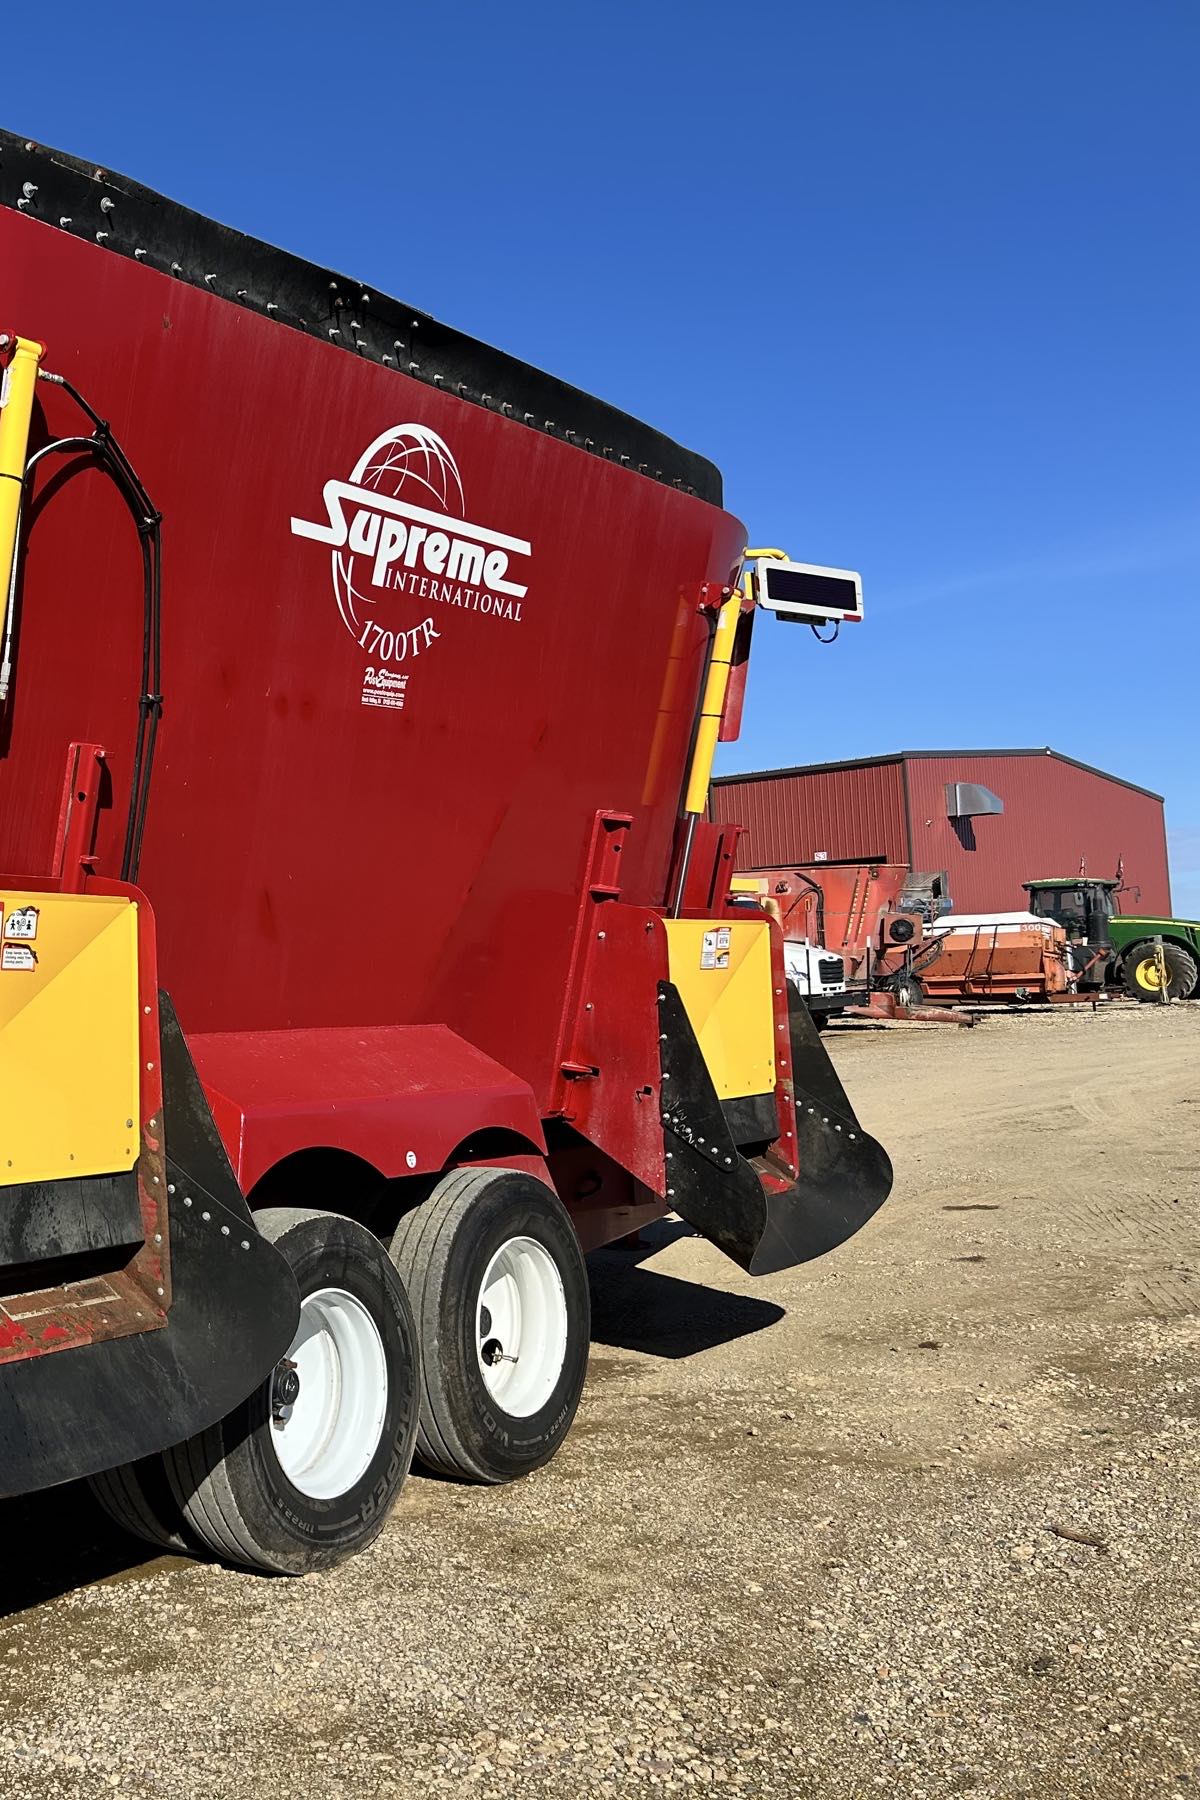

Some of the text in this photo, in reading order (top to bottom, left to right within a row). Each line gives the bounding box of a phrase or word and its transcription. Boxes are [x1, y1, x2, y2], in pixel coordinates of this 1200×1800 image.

[290, 479, 532, 599] Supreme
[384, 567, 523, 623] INTERNATIONAL
[357, 616, 442, 661] 1700TR
[1021, 924, 1041, 932] 300
[276, 1498, 315, 1534] 11R22.5
